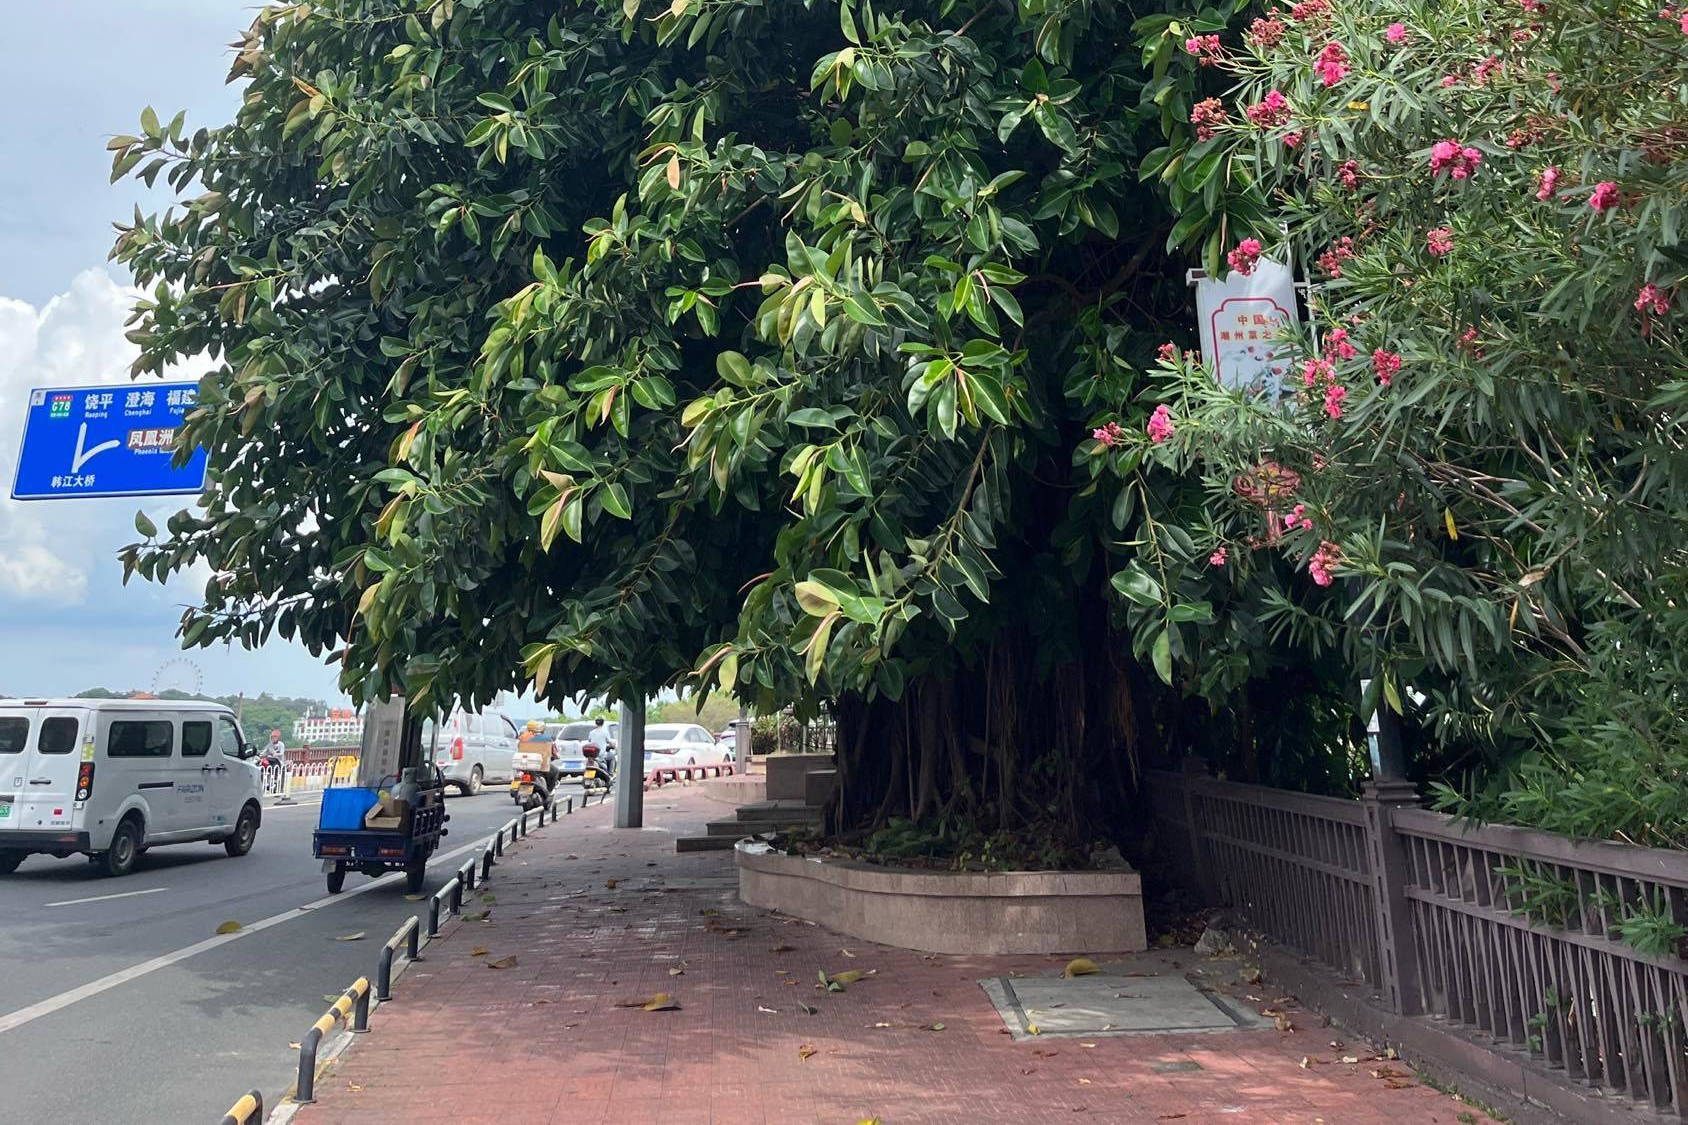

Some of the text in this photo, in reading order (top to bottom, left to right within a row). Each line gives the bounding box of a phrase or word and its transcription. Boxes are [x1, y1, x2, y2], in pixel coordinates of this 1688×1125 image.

[1237, 314, 1264, 325] 中国
[1220, 330, 1272, 341] 潮州菜之
[84, 393, 113, 410] 饶平
[125, 390, 156, 408] 澄海
[52, 401, 71, 412] G78
[124, 408, 152, 417] Chenghai
[169, 407, 185, 415] Fujia
[128, 429, 174, 447] 凤凰洲
[51, 474, 96, 488] 韩江大桥
